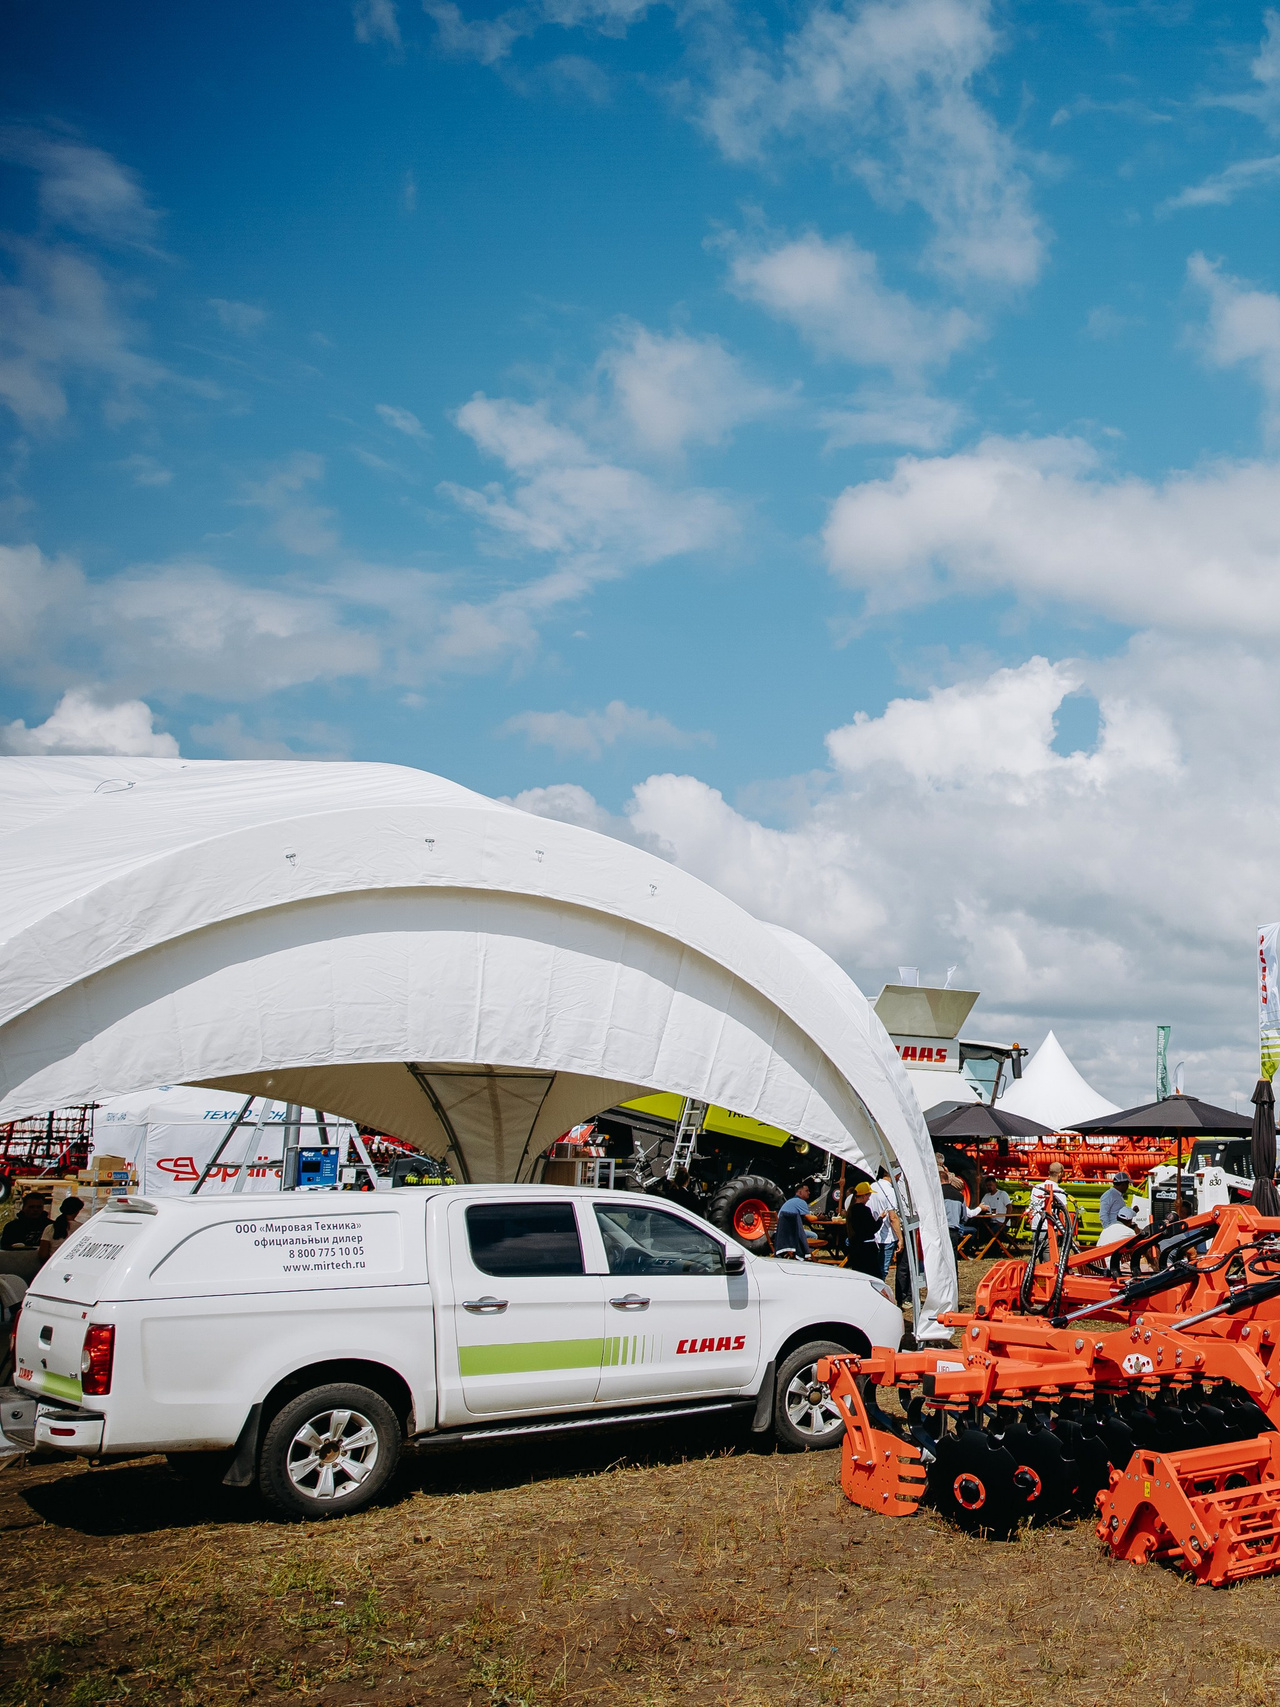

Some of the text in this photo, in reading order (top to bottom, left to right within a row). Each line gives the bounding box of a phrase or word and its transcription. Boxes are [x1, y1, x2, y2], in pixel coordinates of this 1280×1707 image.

[235, 1221, 362, 1235] ООО «Мировая Техника»
[332, 1235, 363, 1245] дилер
[289, 1246, 365, 1259] 8 800 775 10 05
[283, 1260, 366, 1272] www.mirtech.ru
[676, 1335, 746, 1355] CLAAS
